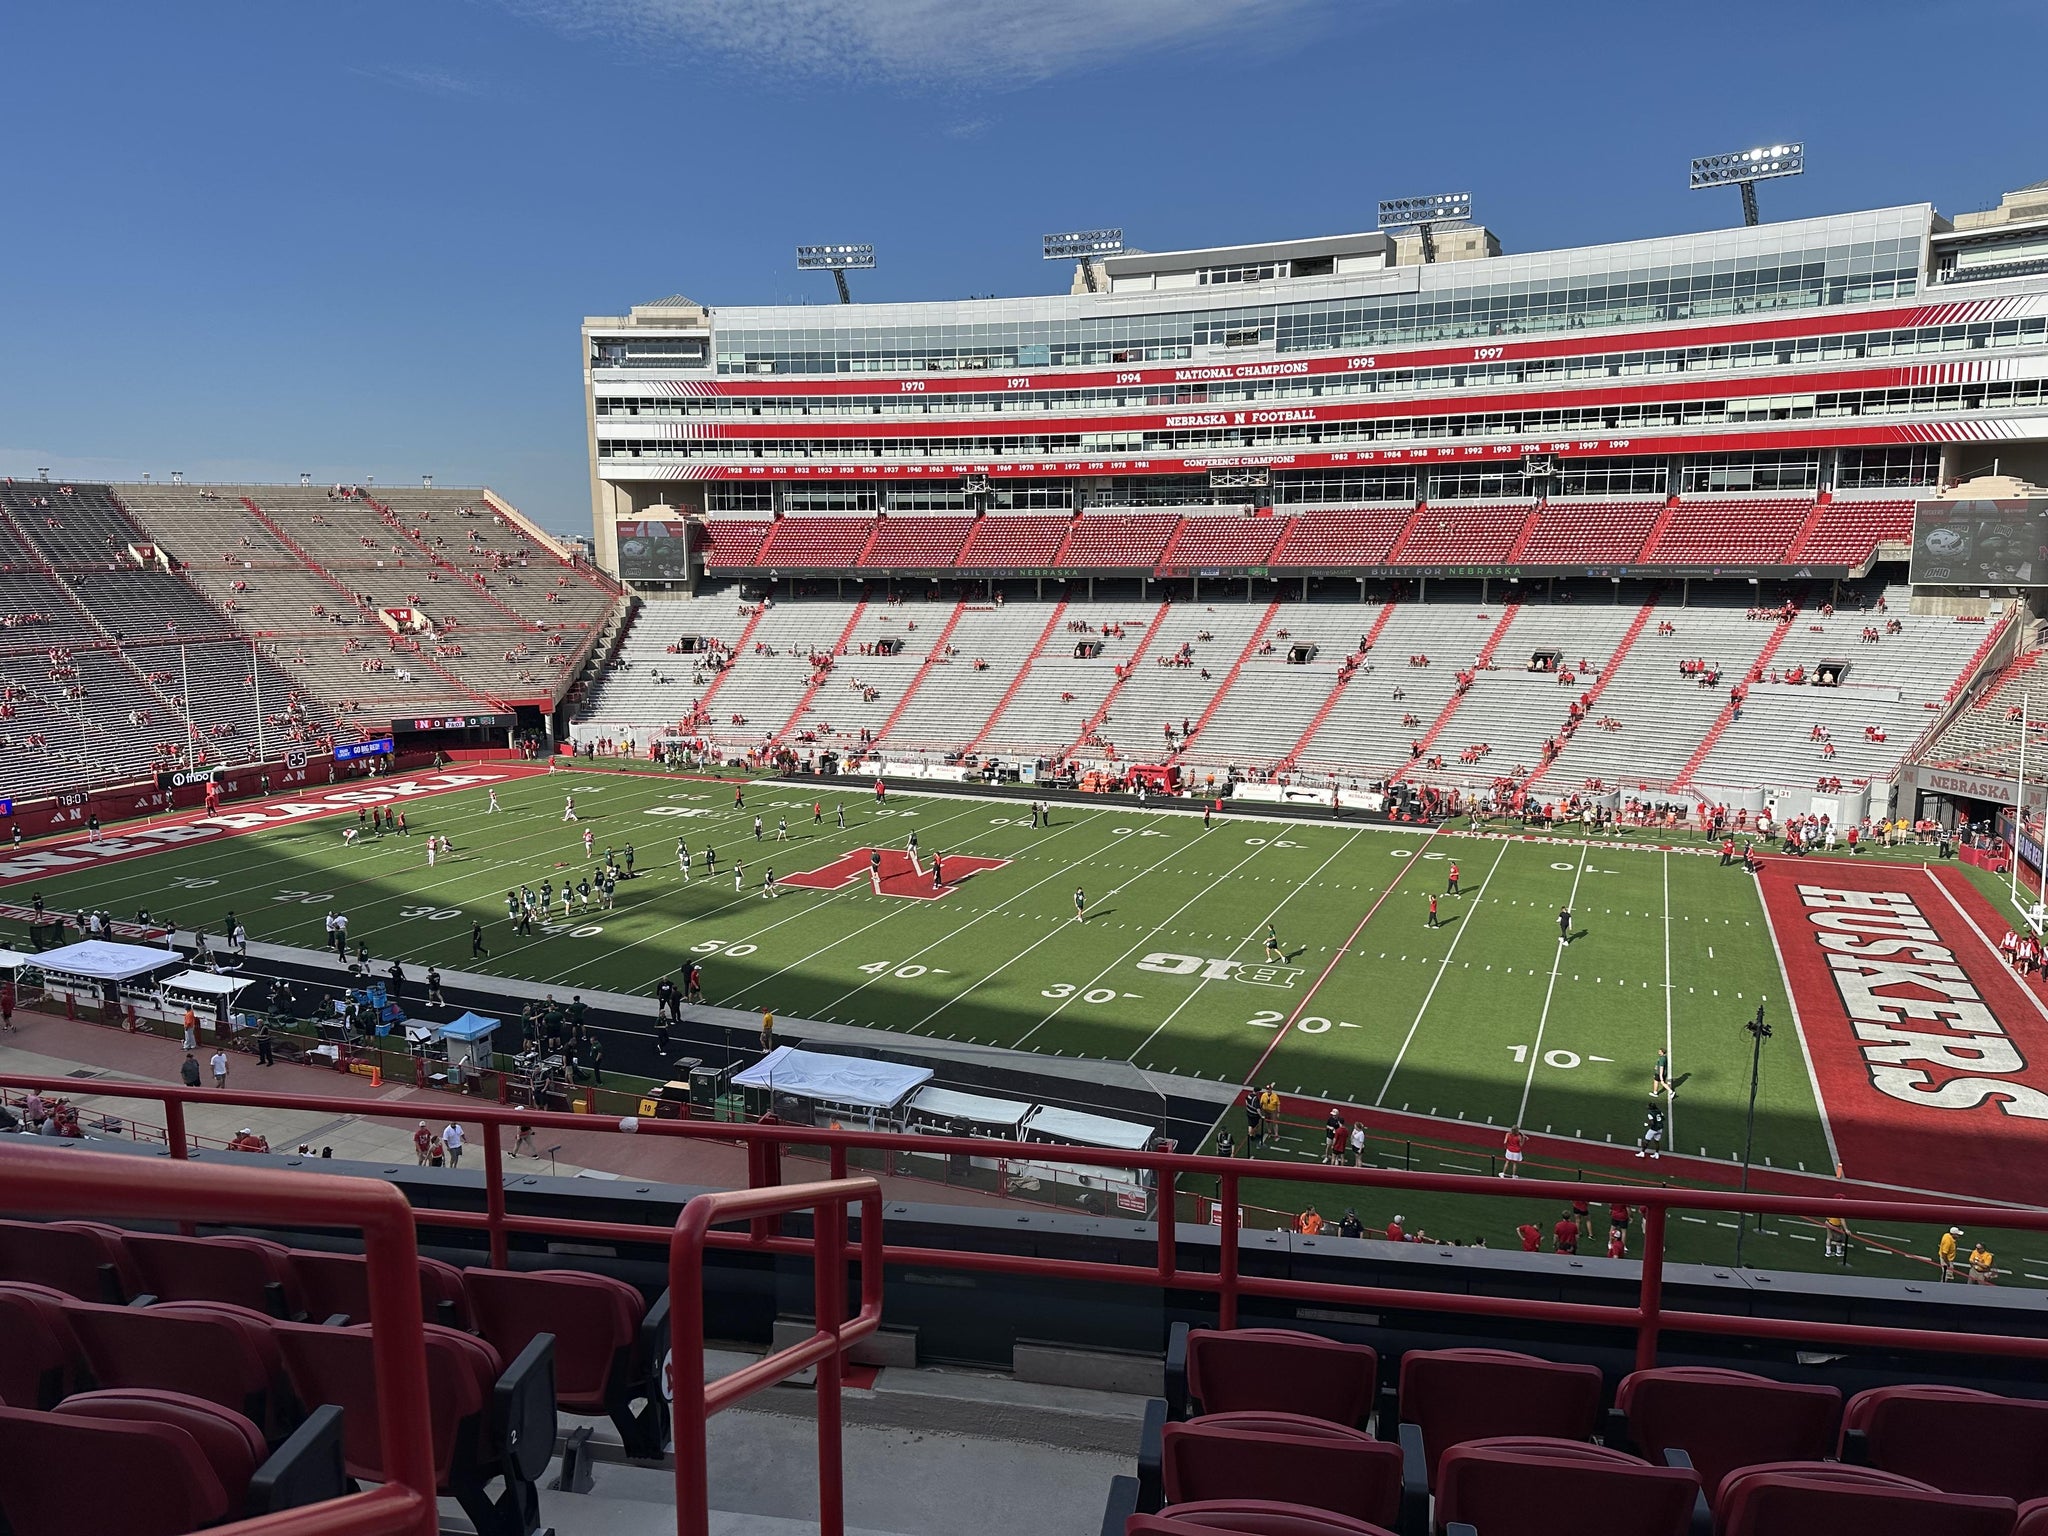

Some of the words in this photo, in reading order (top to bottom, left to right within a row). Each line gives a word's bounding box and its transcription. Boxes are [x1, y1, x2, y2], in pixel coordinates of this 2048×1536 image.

[900, 381, 925, 391] 1970
[1006, 377, 1030, 388] 1971
[1115, 372, 1141, 384] 1994
[1175, 367, 1234, 381] NATIONAL
[1236, 362, 1308, 377] CHAMPIONS
[1347, 357, 1375, 370] 1995
[1473, 347, 1504, 360] 1997
[1165, 414, 1228, 427] NEBRASKA
[1234, 412, 1246, 424] N
[1251, 409, 1317, 423] FOOTBALL
[817, 466, 833, 474] 1933
[862, 466, 878, 474] 1936
[883, 466, 899, 474] 1937
[996, 464, 1013, 472] 1969
[1018, 464, 1034, 472] 1970
[1088, 462, 1104, 470] 1975
[1110, 462, 1127, 470] 1978
[1183, 457, 1240, 467] CONFERENCE
[1240, 455, 1296, 465] CHAMPIONS
[1330, 453, 1349, 461] 1982
[1356, 452, 1375, 460] 1983
[1437, 447, 1455, 456] 1991
[1464, 446, 1483, 455] 1992
[1492, 445, 1512, 454] 1993
[1520, 444, 1541, 453] 1994
[1550, 442, 1571, 451] 1995
[1578, 441, 1599, 450] 1997
[1609, 439, 1630, 449] 1999
[1371, 568, 1410, 576] BUILT
[1449, 567, 1522, 575] NEBRASKA
[1924, 568, 1950, 578] OHIO
[420, 720, 429, 728] N
[353, 746, 361, 754] GO
[361, 745, 370, 753] BIG
[290, 753, 305, 766] 25
[297, 770, 306, 780] N
[1903, 771, 1914, 783] N
[228, 781, 238, 792] N
[1930, 775, 2010, 801] NEBRASKA
[152, 794, 163, 806] N
[2029, 792, 2042, 805] N
[69, 808, 82, 820] N
[0, 771, 509, 879] NEBRASKA
[1245, 838, 1298, 849] 30
[1390, 849, 1449, 861] 20
[1549, 861, 1598, 873] 10
[773, 846, 1013, 902] N
[271, 890, 335, 904] 20
[399, 906, 463, 920] 30
[538, 923, 604, 938] 40
[690, 940, 758, 957] 50
[857, 960, 928, 978] 40
[1041, 983, 1117, 1004] 30
[1797, 884, 2048, 1121] HUSKERS
[1246, 1011, 1332, 1034] 20
[1506, 1044, 1581, 1069] 10
[644, 1104, 652, 1112] 10
[1656, 1113, 1662, 1122] 6
[510, 1429, 518, 1445] 2
